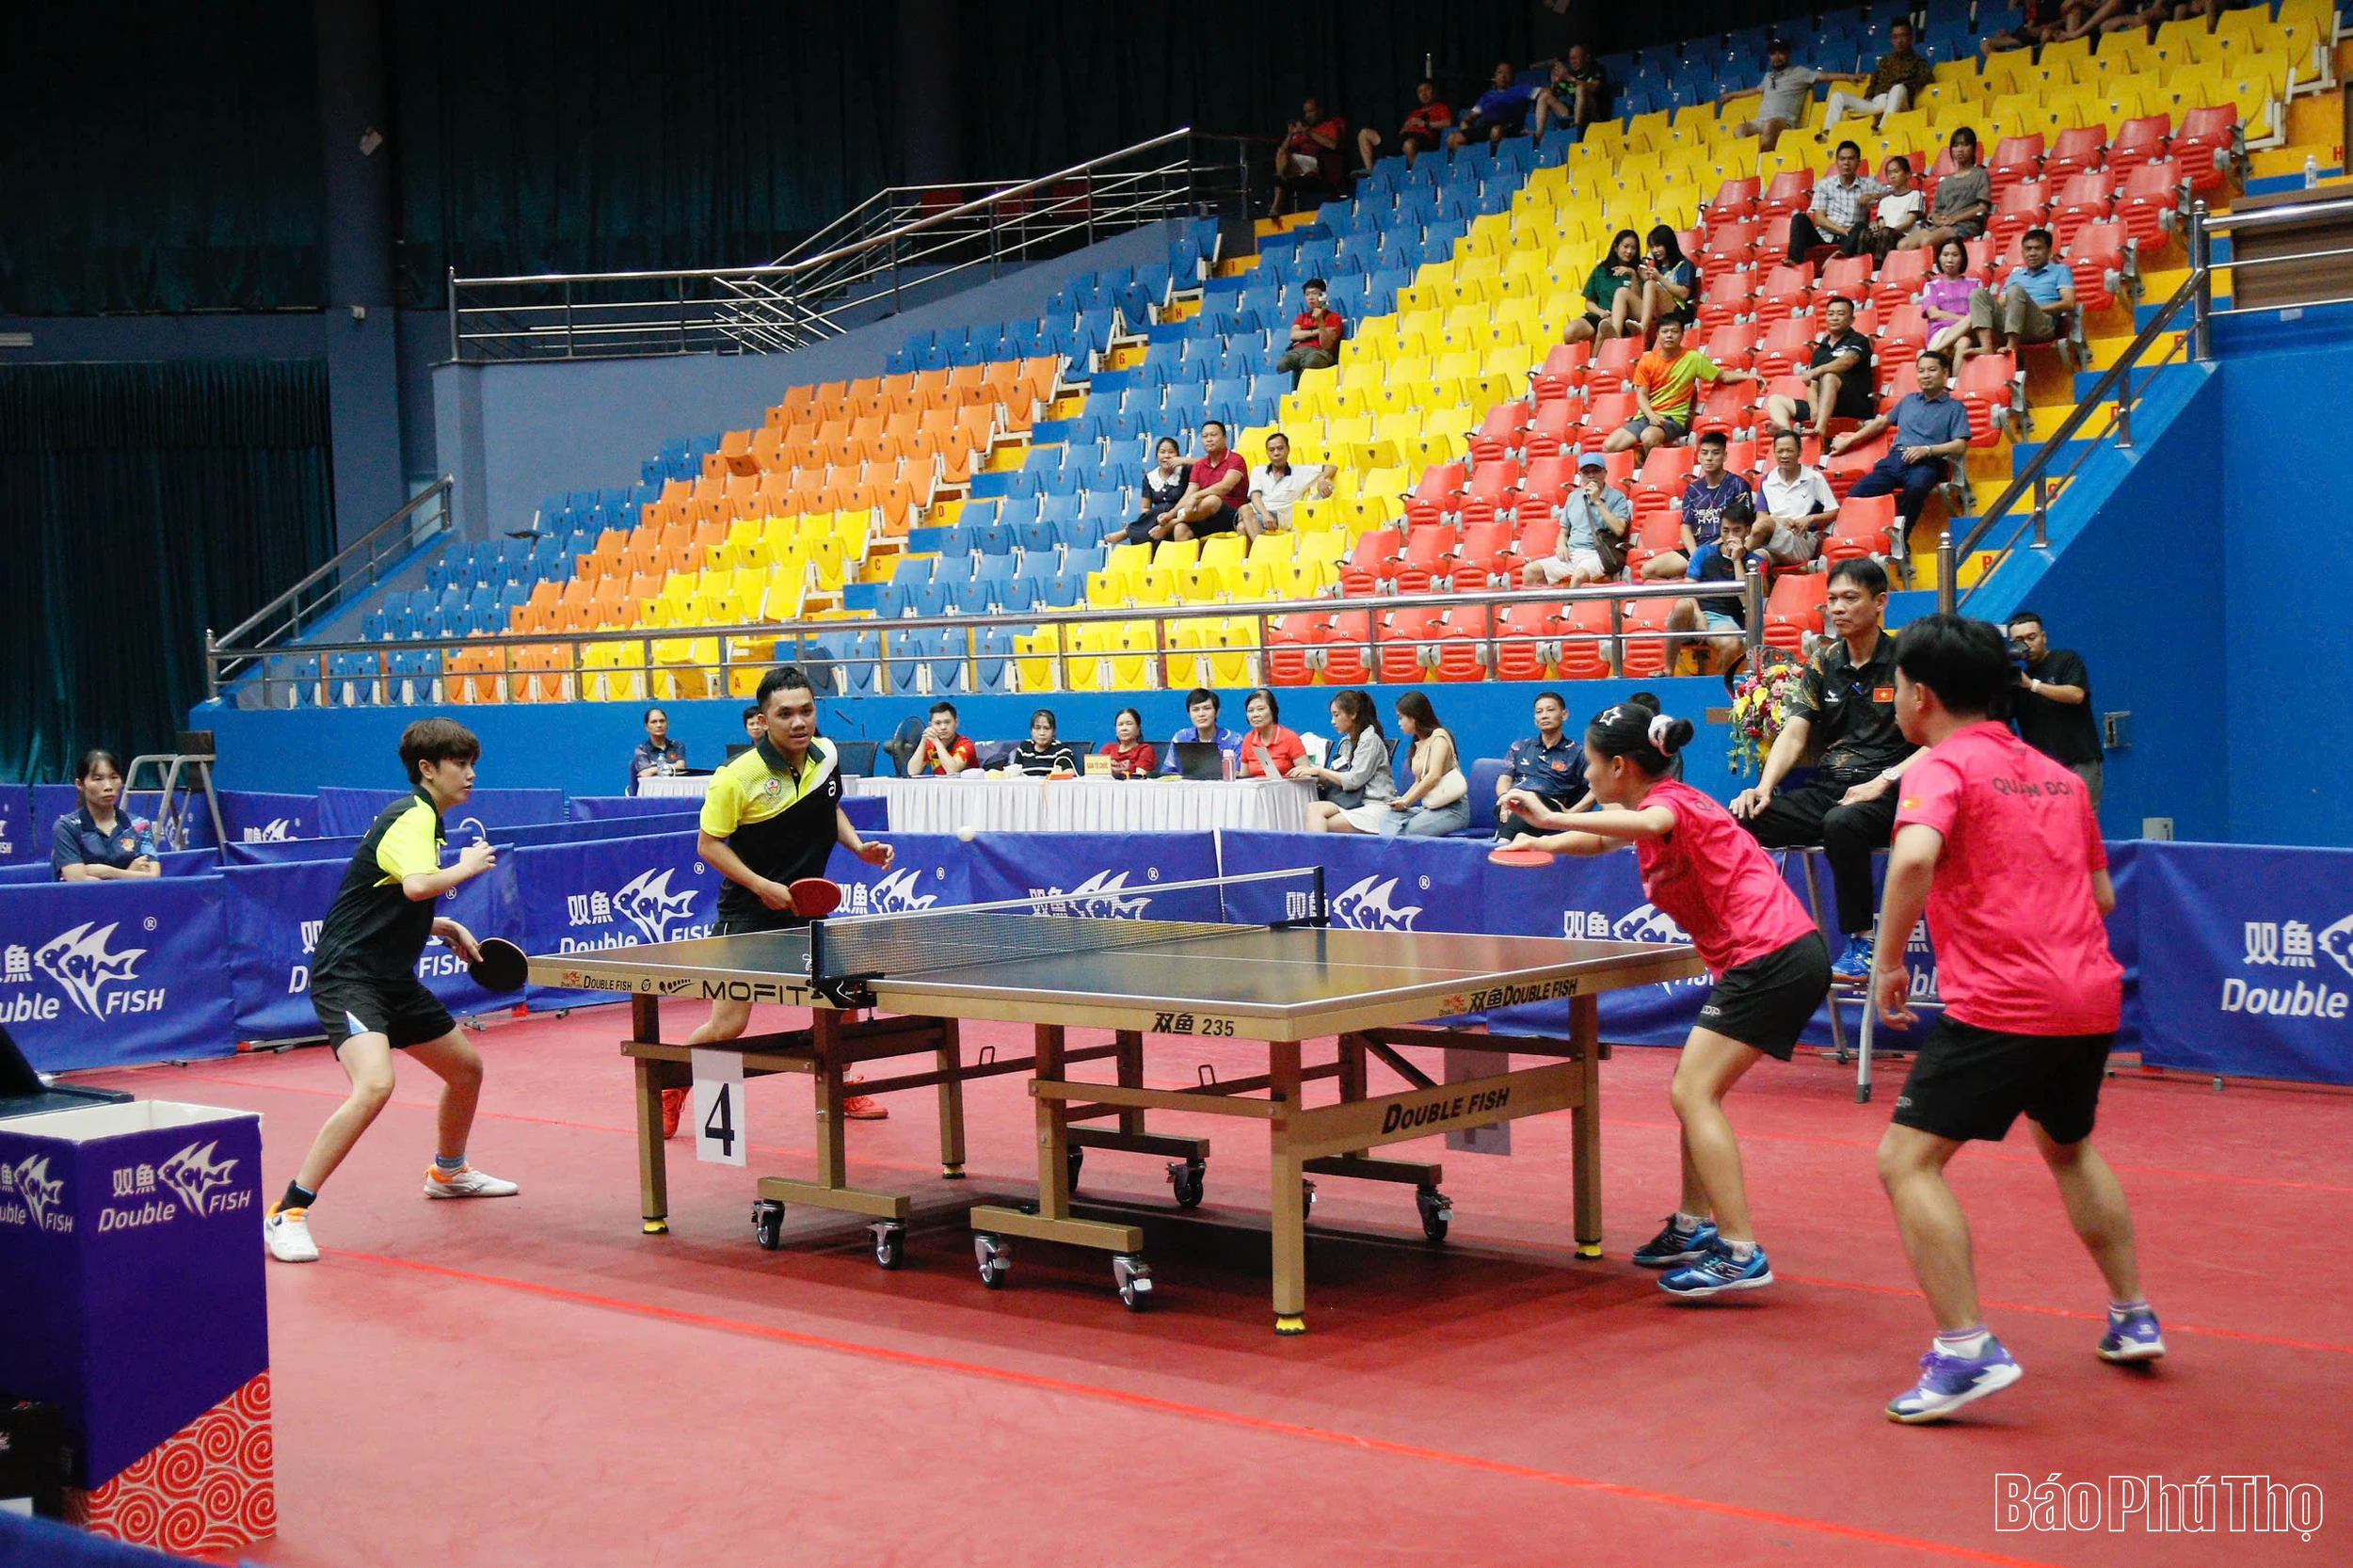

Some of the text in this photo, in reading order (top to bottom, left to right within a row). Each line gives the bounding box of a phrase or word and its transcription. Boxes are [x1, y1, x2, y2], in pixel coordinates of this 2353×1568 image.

[874, 558, 881, 570] C
[734, 676, 741, 689] A
[418, 954, 468, 979] FISH
[584, 975, 615, 990] DOUBLE
[615, 981, 632, 992] FISH
[1501, 984, 1552, 1006] DOUBLE
[1553, 978, 1578, 998] FISH
[105, 988, 166, 1015] FISH
[2220, 978, 2349, 1018] Double
[1151, 1011, 1235, 1036] 双鱼 235
[705, 1082, 735, 1157] 4
[1382, 1097, 1464, 1134] DOUBLE
[1467, 1087, 1511, 1114] FISH
[46, 1212, 74, 1234] FISH
[97, 1190, 252, 1233] Double FISH
